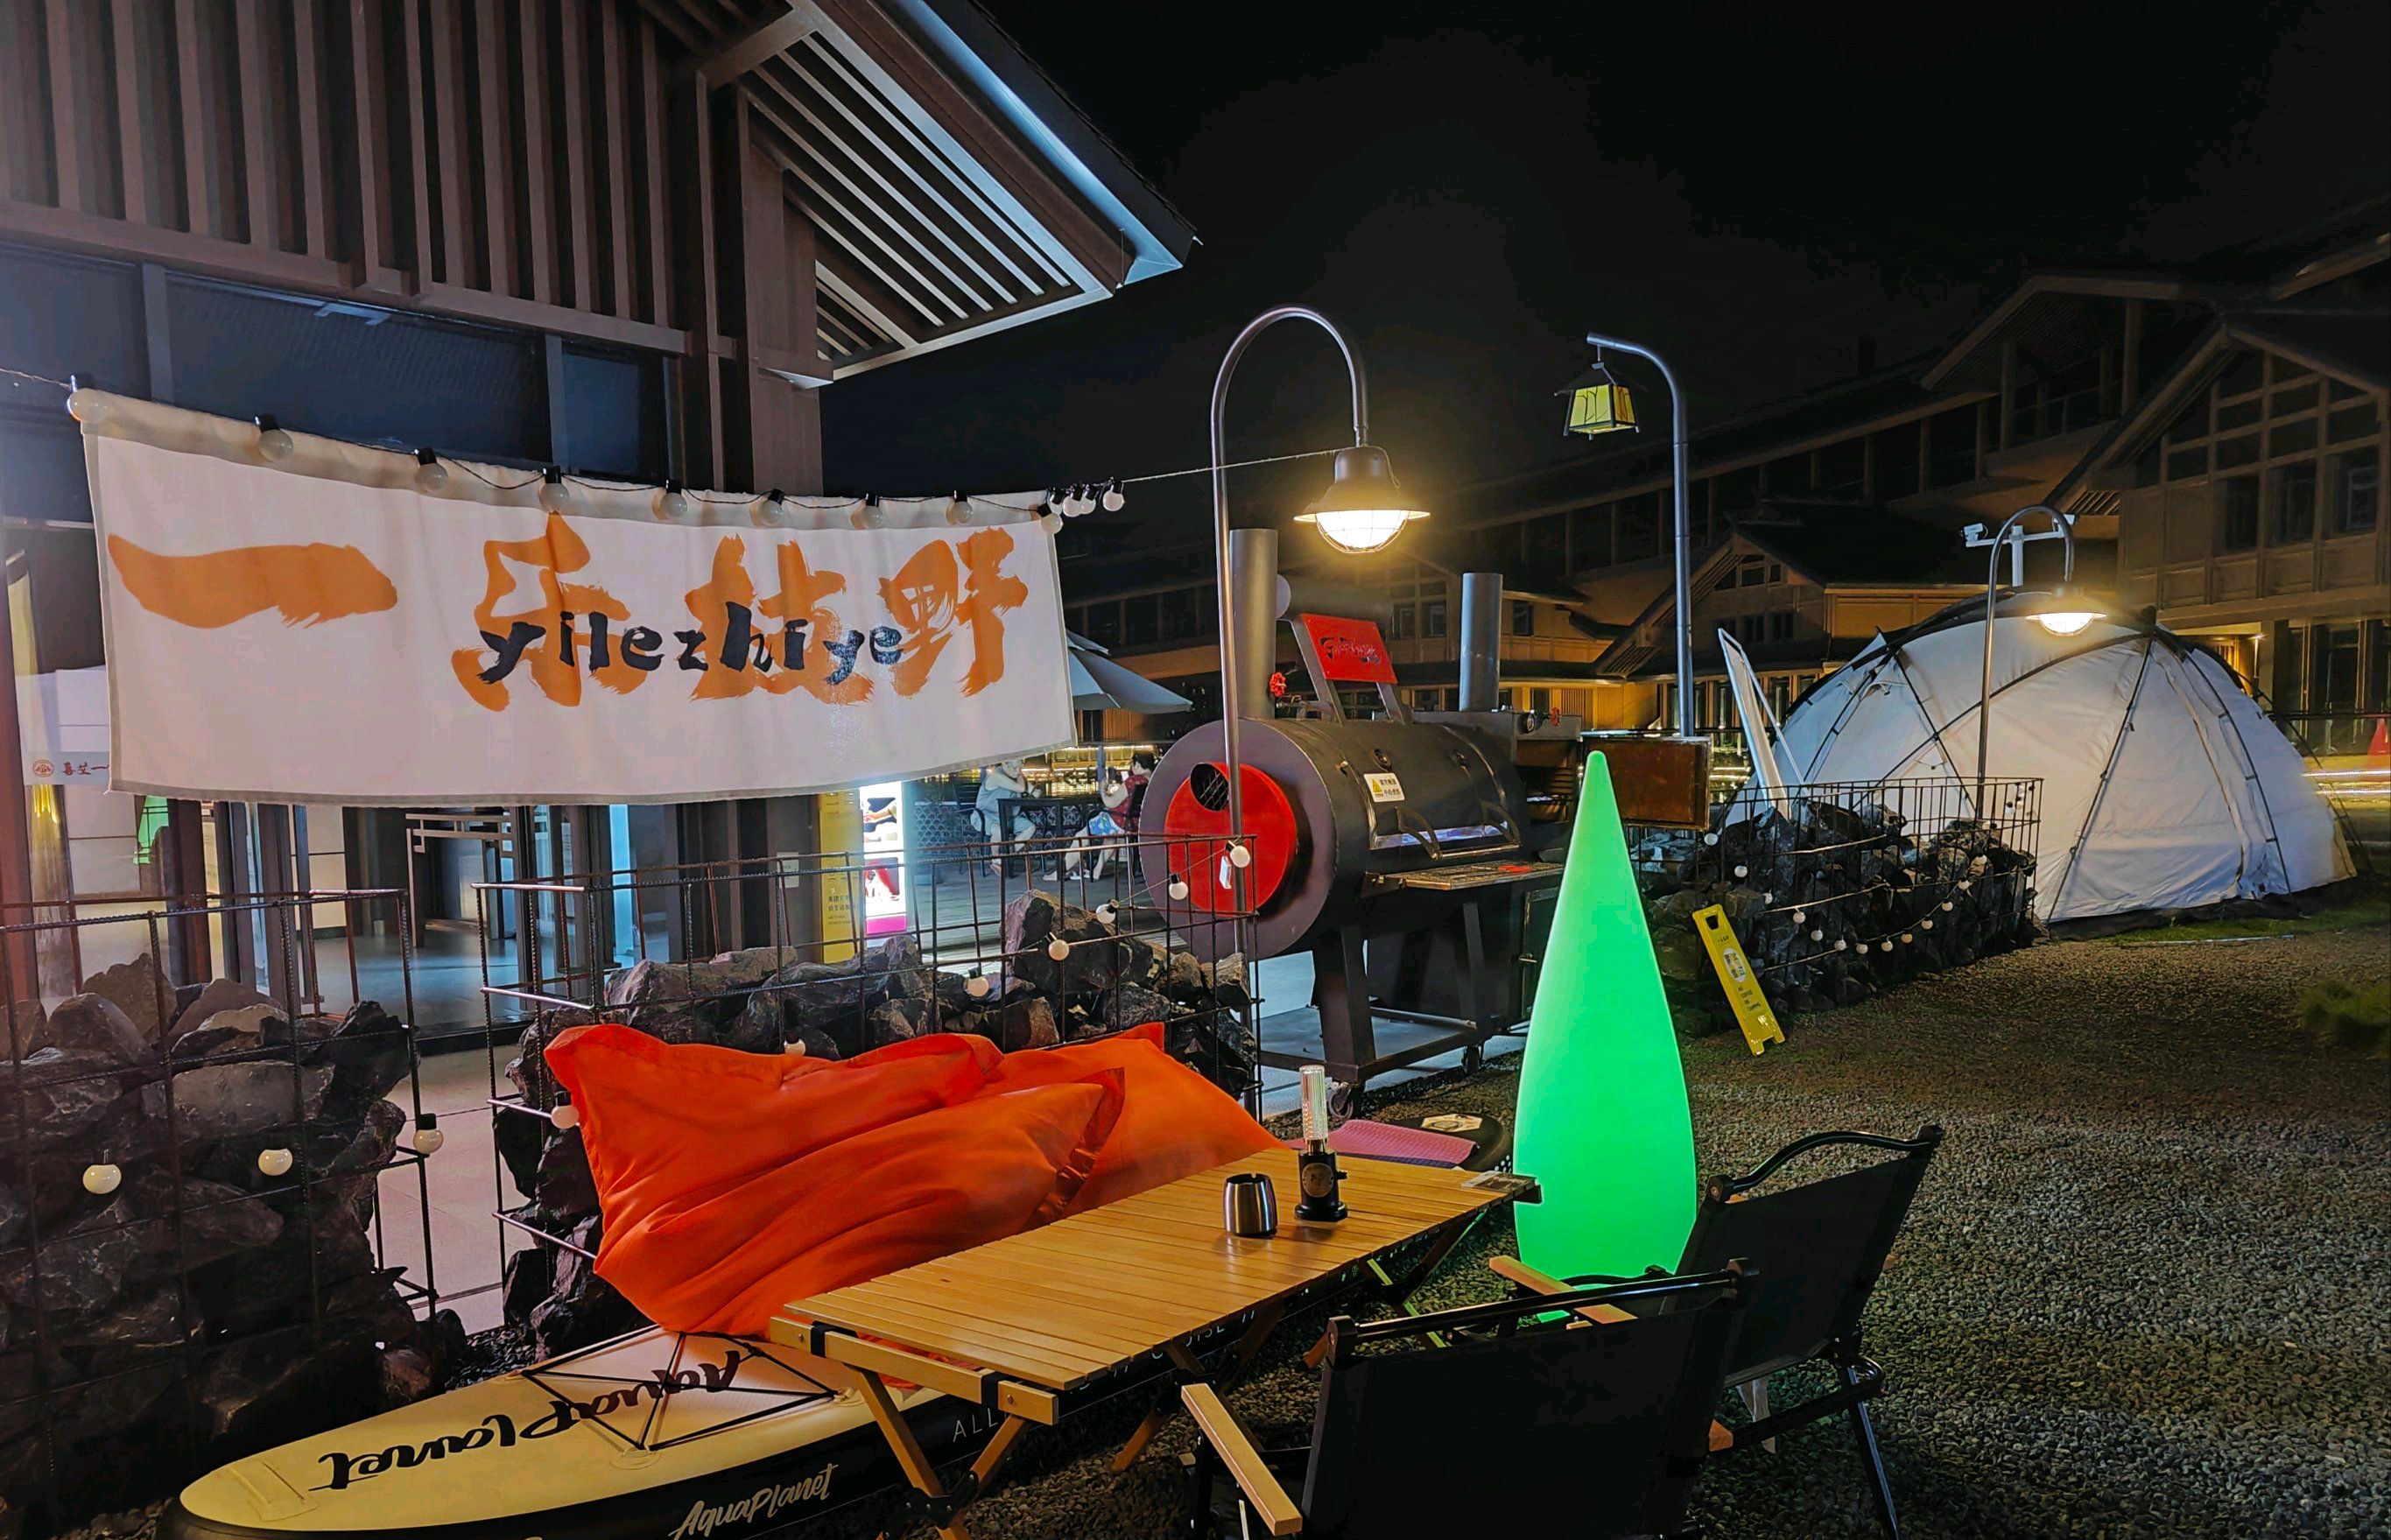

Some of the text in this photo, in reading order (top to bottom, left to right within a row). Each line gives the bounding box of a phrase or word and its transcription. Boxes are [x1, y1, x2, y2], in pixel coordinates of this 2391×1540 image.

[475, 601, 903, 686] yilezhiye
[308, 1350, 741, 1492] AquaPlanet
[668, 1462, 839, 1540] AquaPlanet
